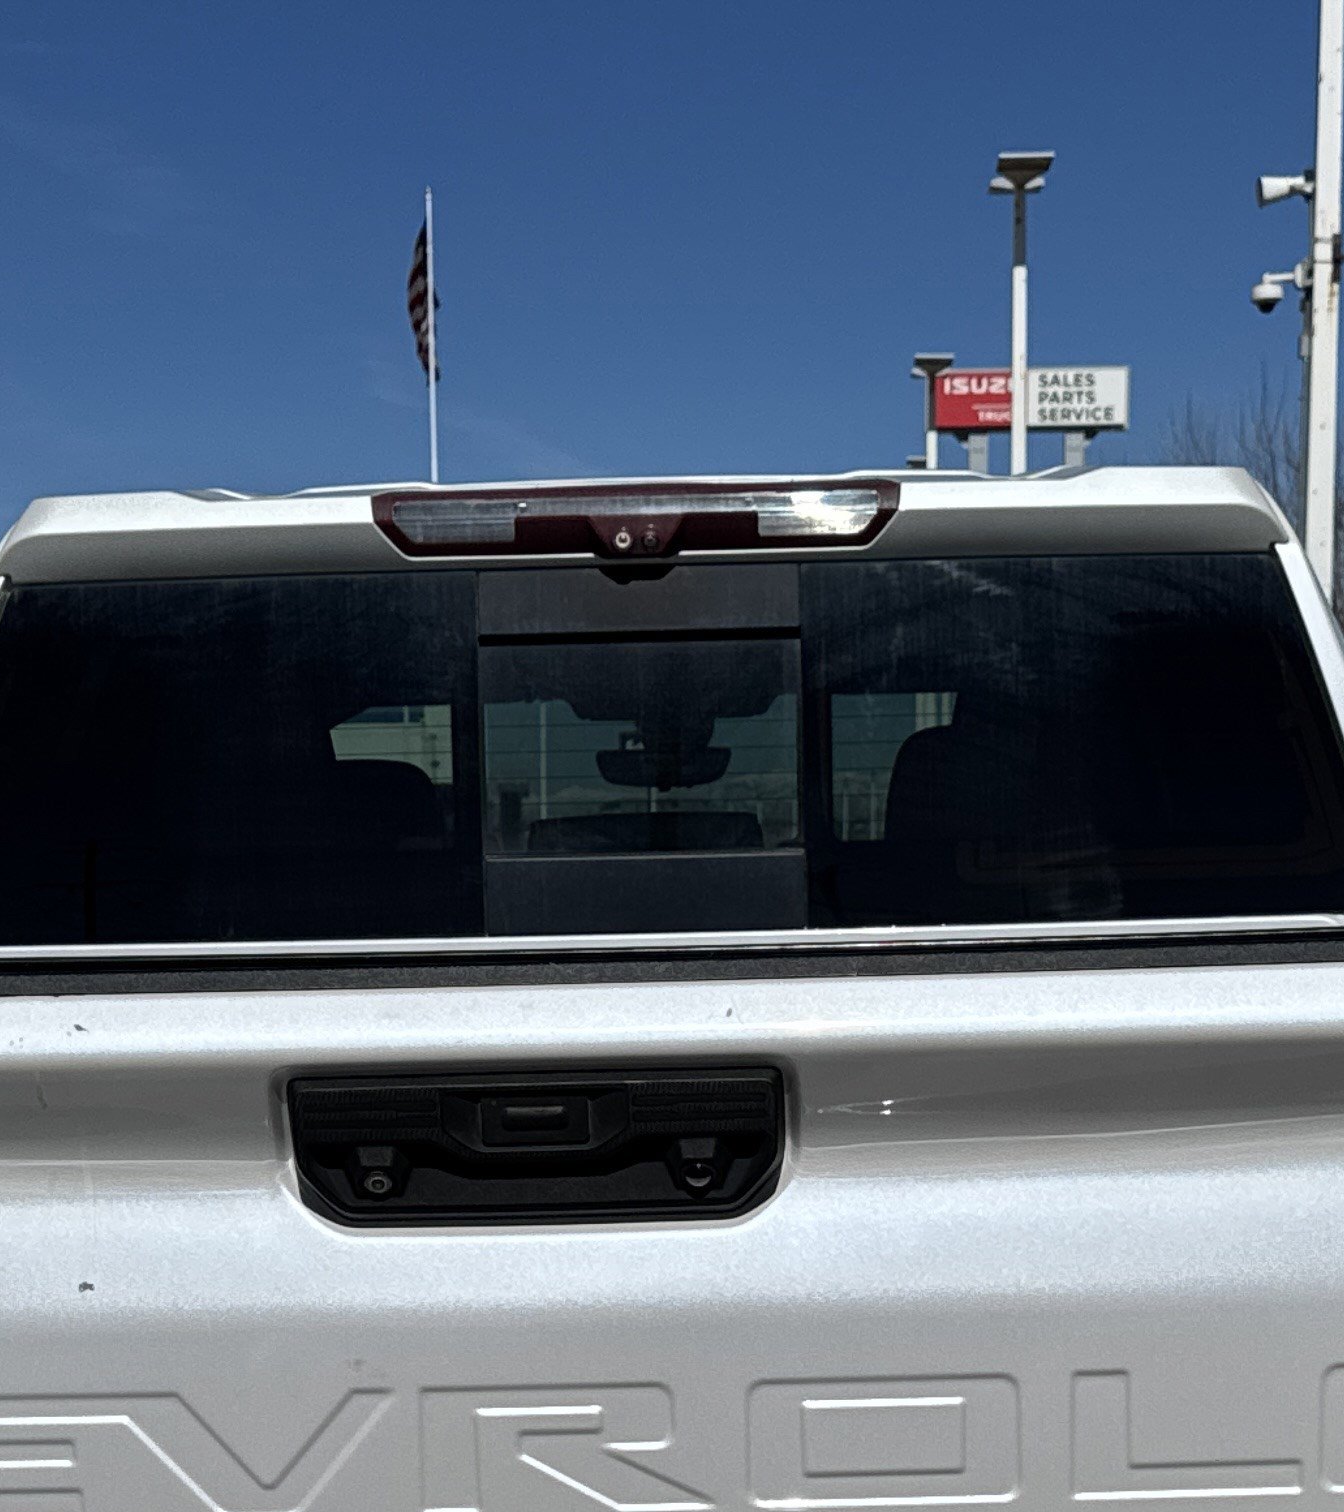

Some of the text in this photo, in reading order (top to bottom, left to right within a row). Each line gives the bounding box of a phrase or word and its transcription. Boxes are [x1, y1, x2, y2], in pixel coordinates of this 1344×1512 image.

[1037, 373, 1095, 388] SALES
[1037, 390, 1096, 404] PARTS
[1037, 407, 1114, 421] SERVICE
